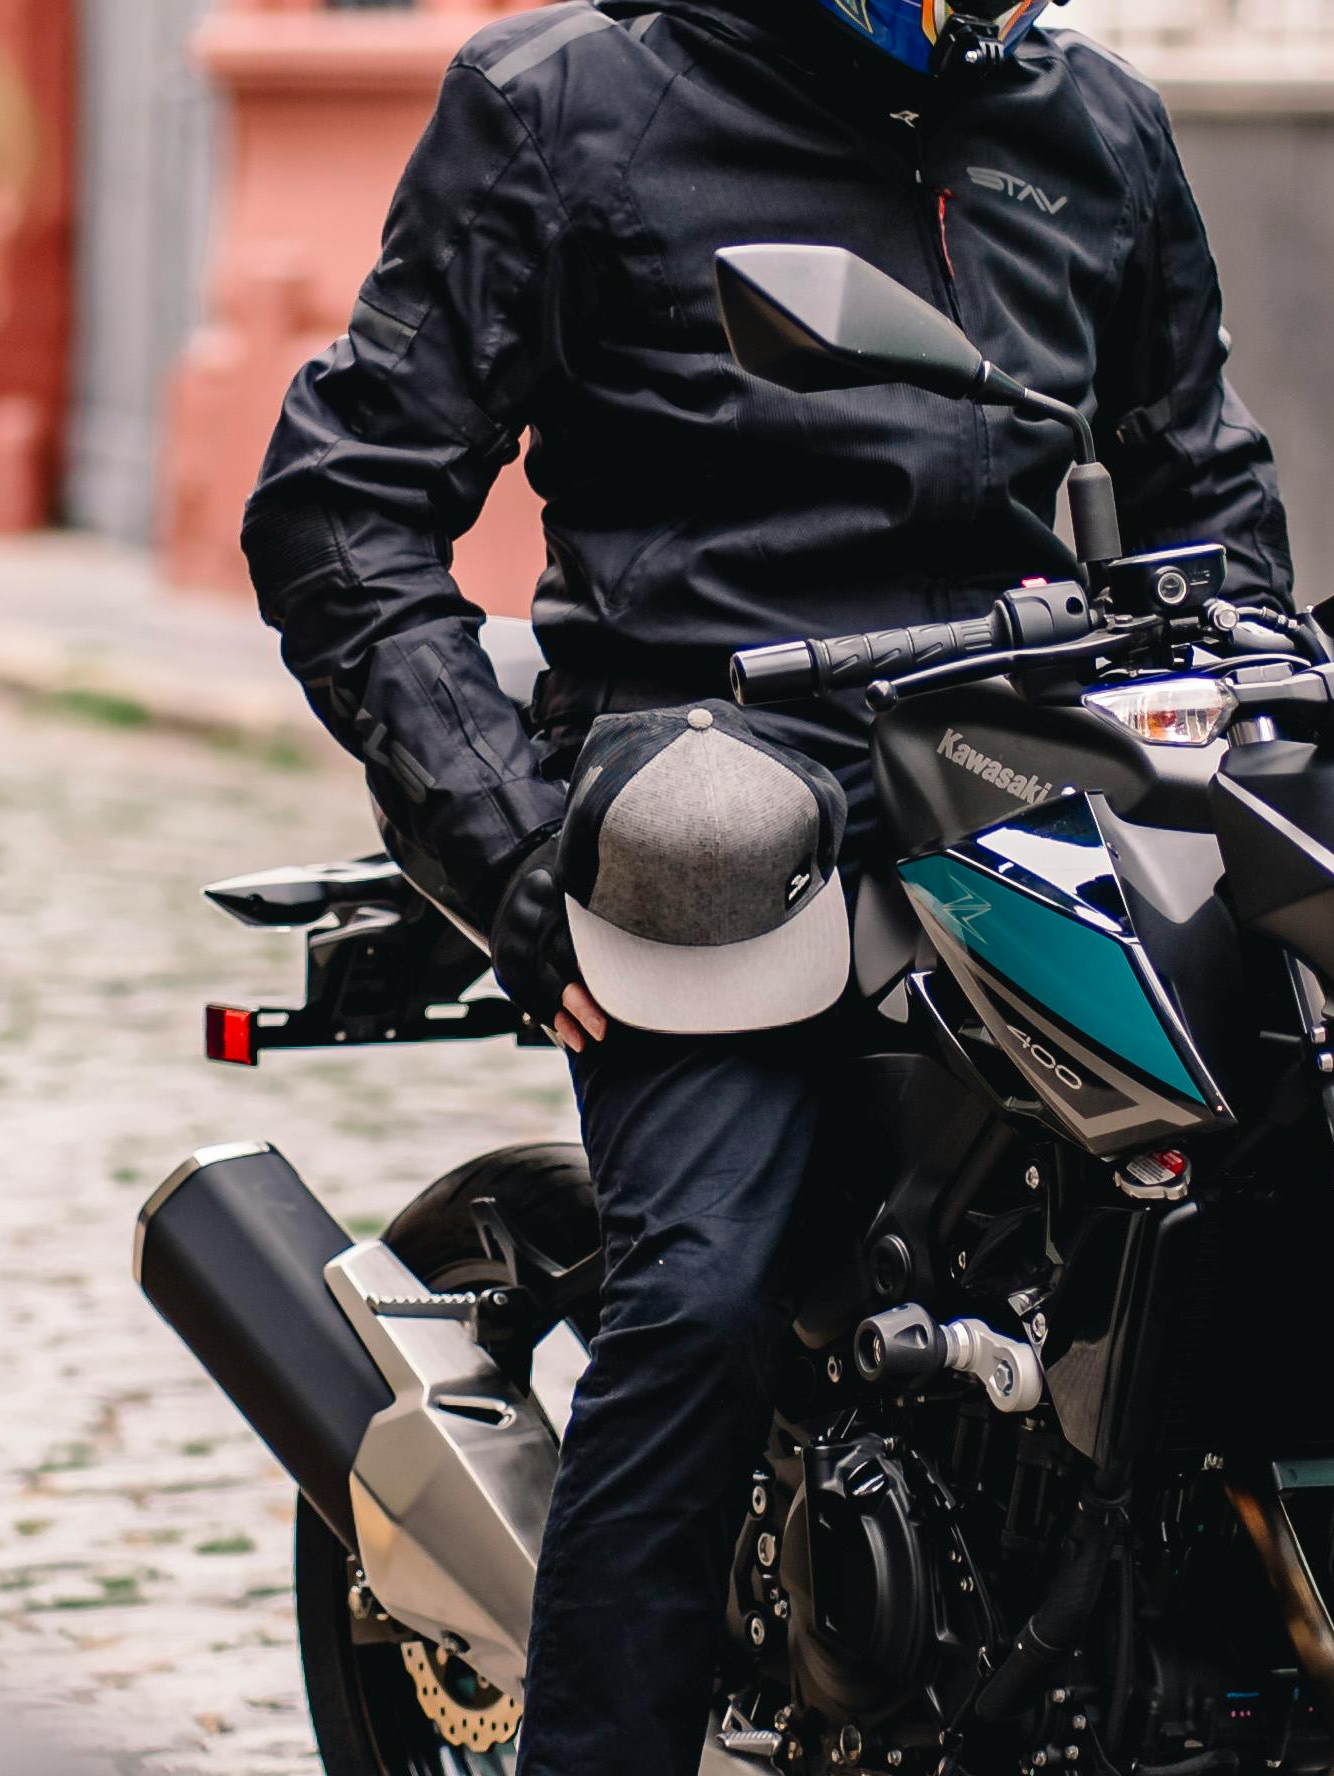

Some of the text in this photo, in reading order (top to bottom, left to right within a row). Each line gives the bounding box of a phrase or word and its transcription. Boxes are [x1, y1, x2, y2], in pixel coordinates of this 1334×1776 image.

[967, 166, 1067, 215] STAV
[936, 727, 1053, 805] Kawasaki
[1006, 1025, 1083, 1091] 400
